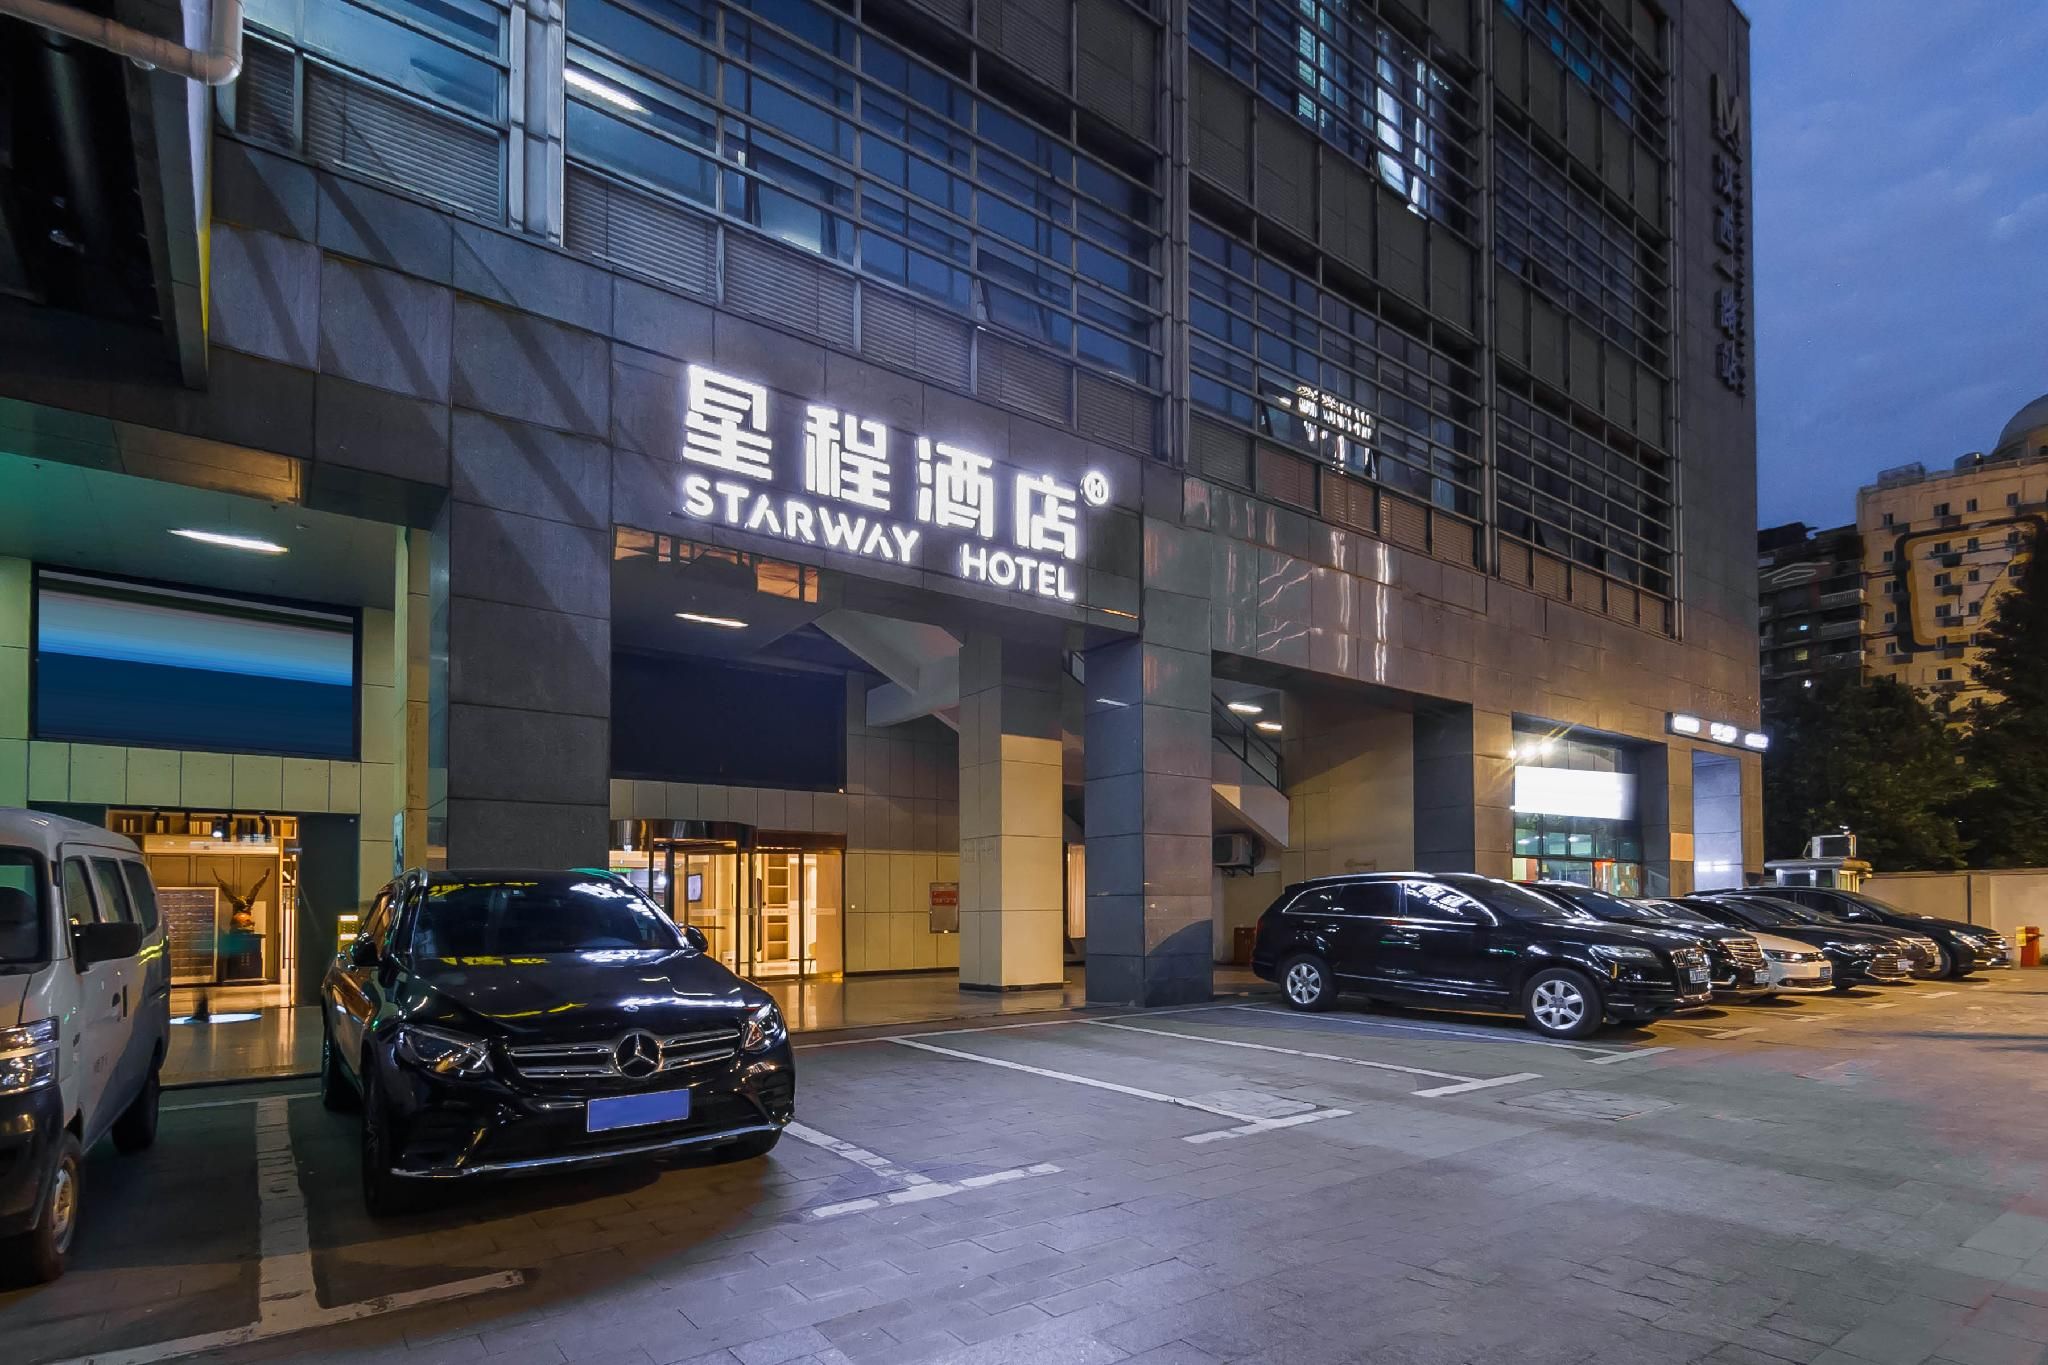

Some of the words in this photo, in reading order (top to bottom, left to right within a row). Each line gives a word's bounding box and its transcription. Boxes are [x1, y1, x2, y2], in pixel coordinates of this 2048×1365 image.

[682, 364, 1077, 560] 星程酒店
[683, 475, 919, 562] STARWAY
[962, 543, 1075, 601] HOTEL
